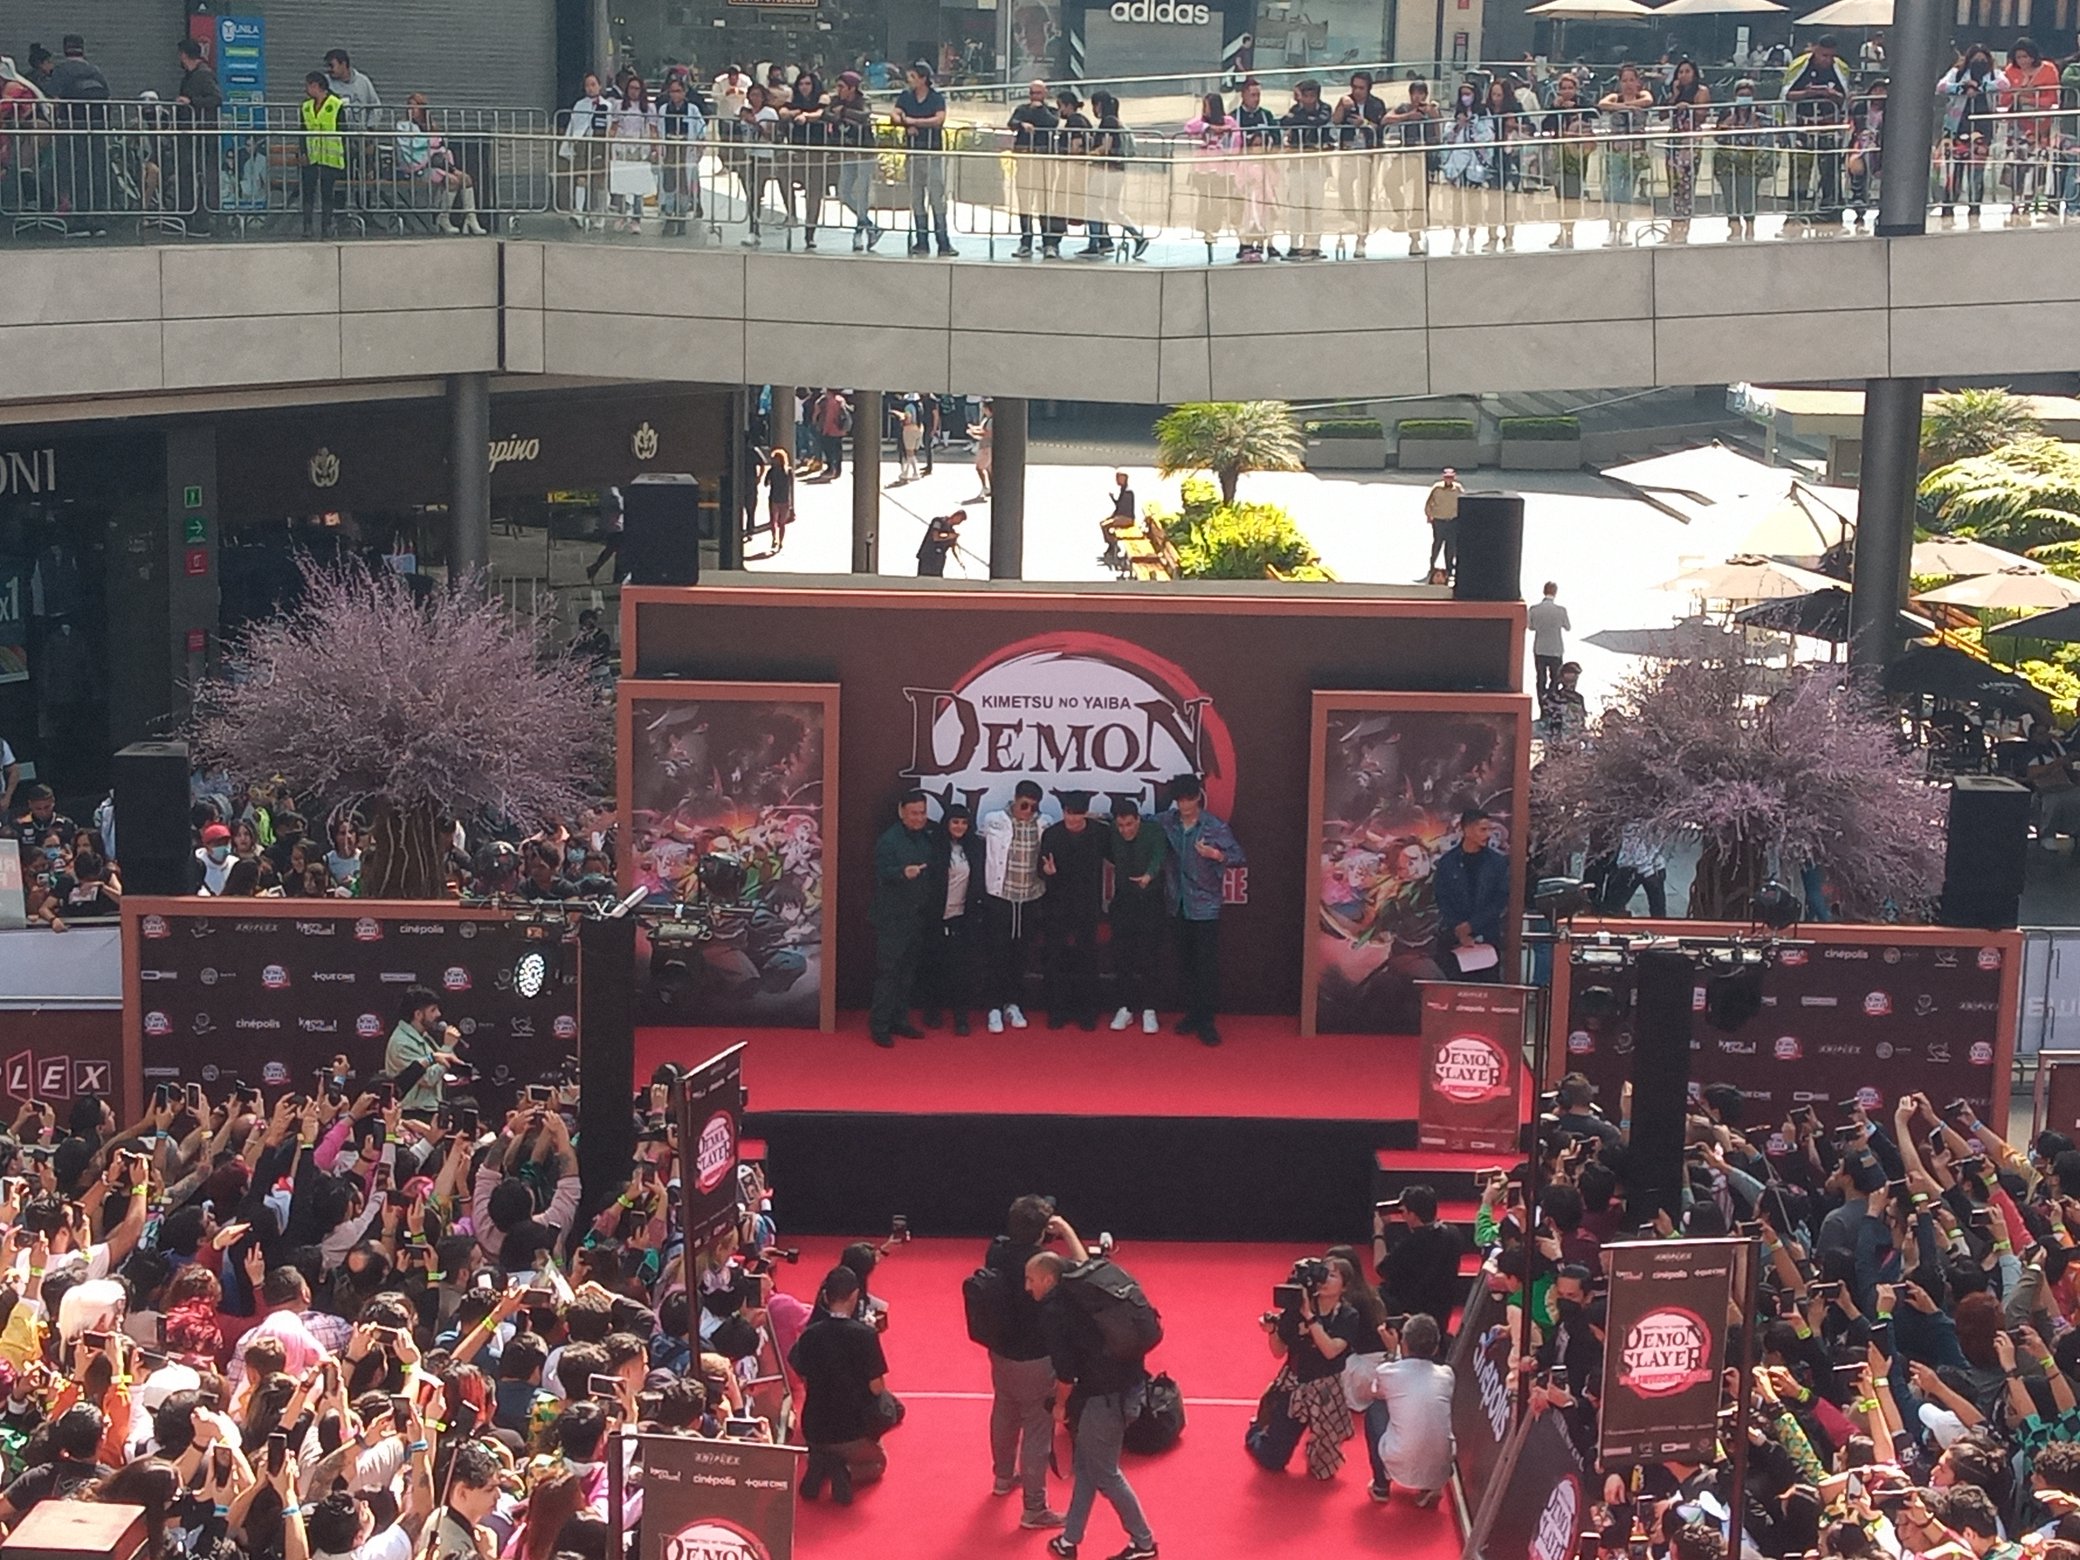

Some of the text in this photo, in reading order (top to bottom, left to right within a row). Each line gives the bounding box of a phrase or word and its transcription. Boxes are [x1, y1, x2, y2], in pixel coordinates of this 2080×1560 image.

[1110, 0, 1210, 25] adidas
[488, 433, 540, 473] pino
[981, 695, 1132, 711] KIMETSU NO YAIBA
[899, 687, 1221, 779] DEMON
[399, 922, 445, 935] cinépolis
[1824, 948, 1869, 961] cinépolis
[235, 1017, 281, 1030] cinépolis
[1433, 1044, 1503, 1068] DEMON
[0, 1065, 107, 1090] LEX
[1431, 1066, 1503, 1087] SLAYER
[1620, 1324, 1705, 1351] DEMON
[1618, 1346, 1703, 1374] SLAYER
[692, 1473, 737, 1488] cinépolis
